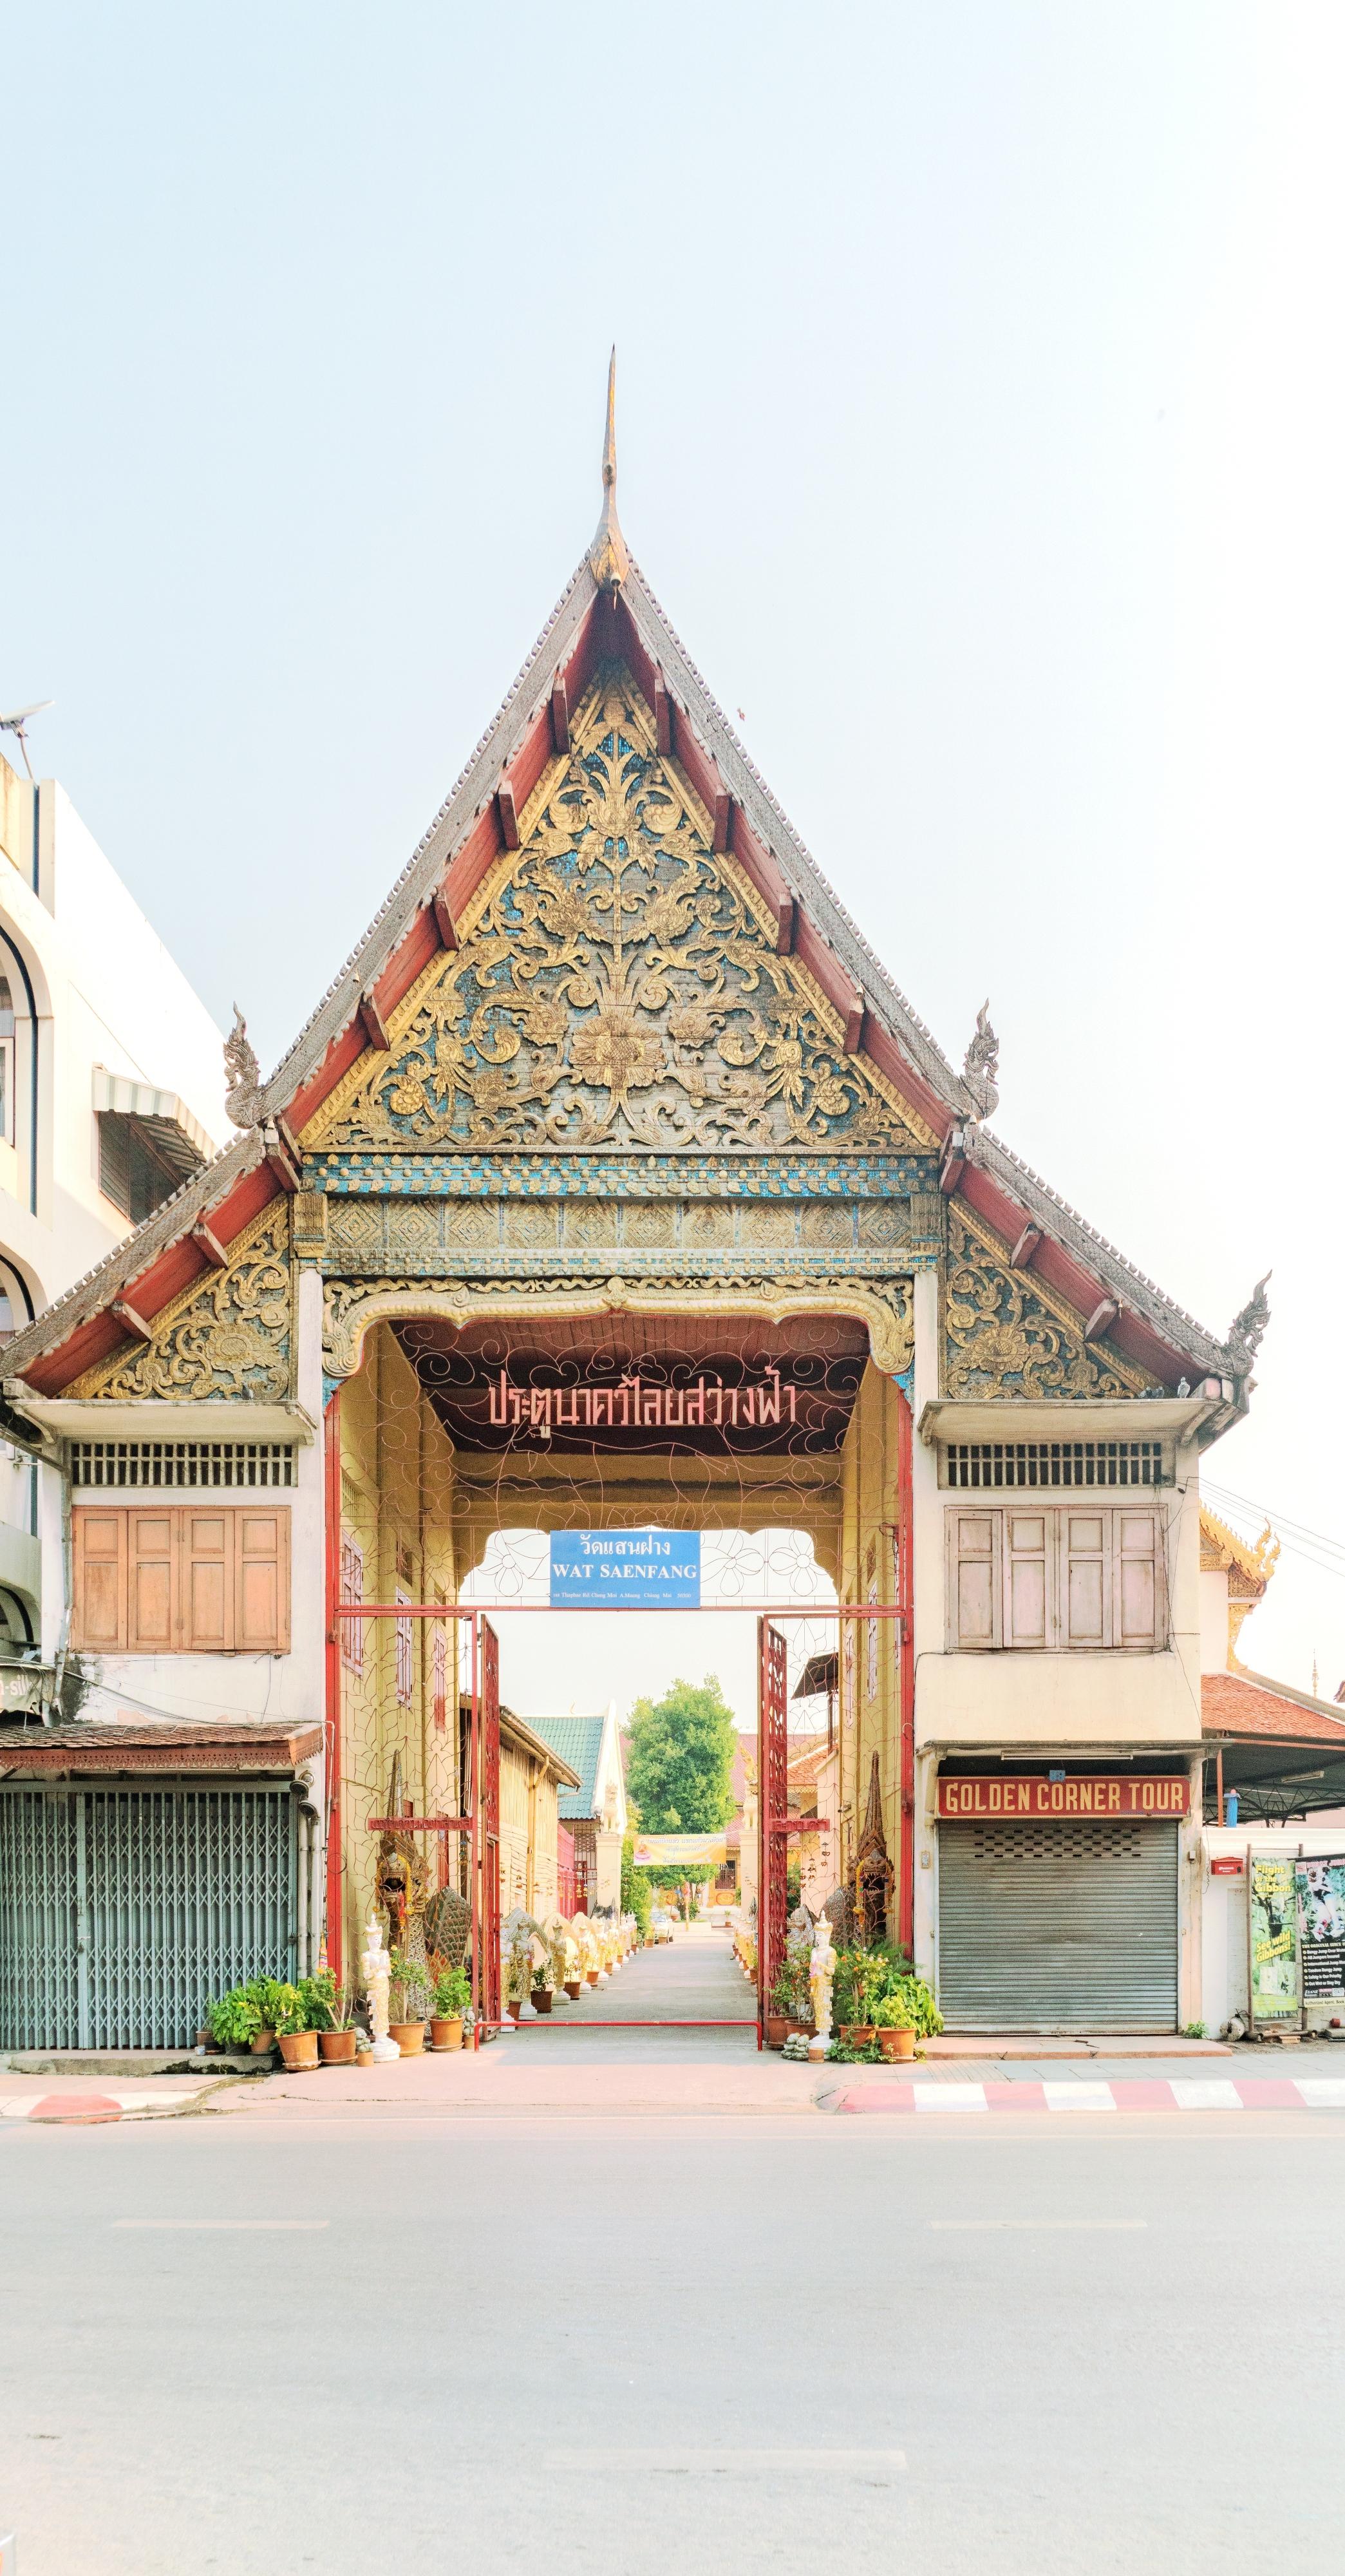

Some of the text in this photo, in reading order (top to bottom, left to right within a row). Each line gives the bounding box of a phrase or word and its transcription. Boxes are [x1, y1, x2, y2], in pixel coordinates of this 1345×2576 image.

[579, 1533, 670, 1555] วัดแสนฝาง
[552, 1564, 697, 1578] WAT SAENFANG
[946, 1782, 1183, 1812] GOLDEN CORNER TOUR
[1256, 1864, 1285, 1875] Flight
[1265, 1874, 1277, 1882] the
[1255, 1882, 1292, 1892] Gibbon
[1256, 1929, 1291, 1953] See wild
[1256, 1940, 1291, 1962] Gibbons!
